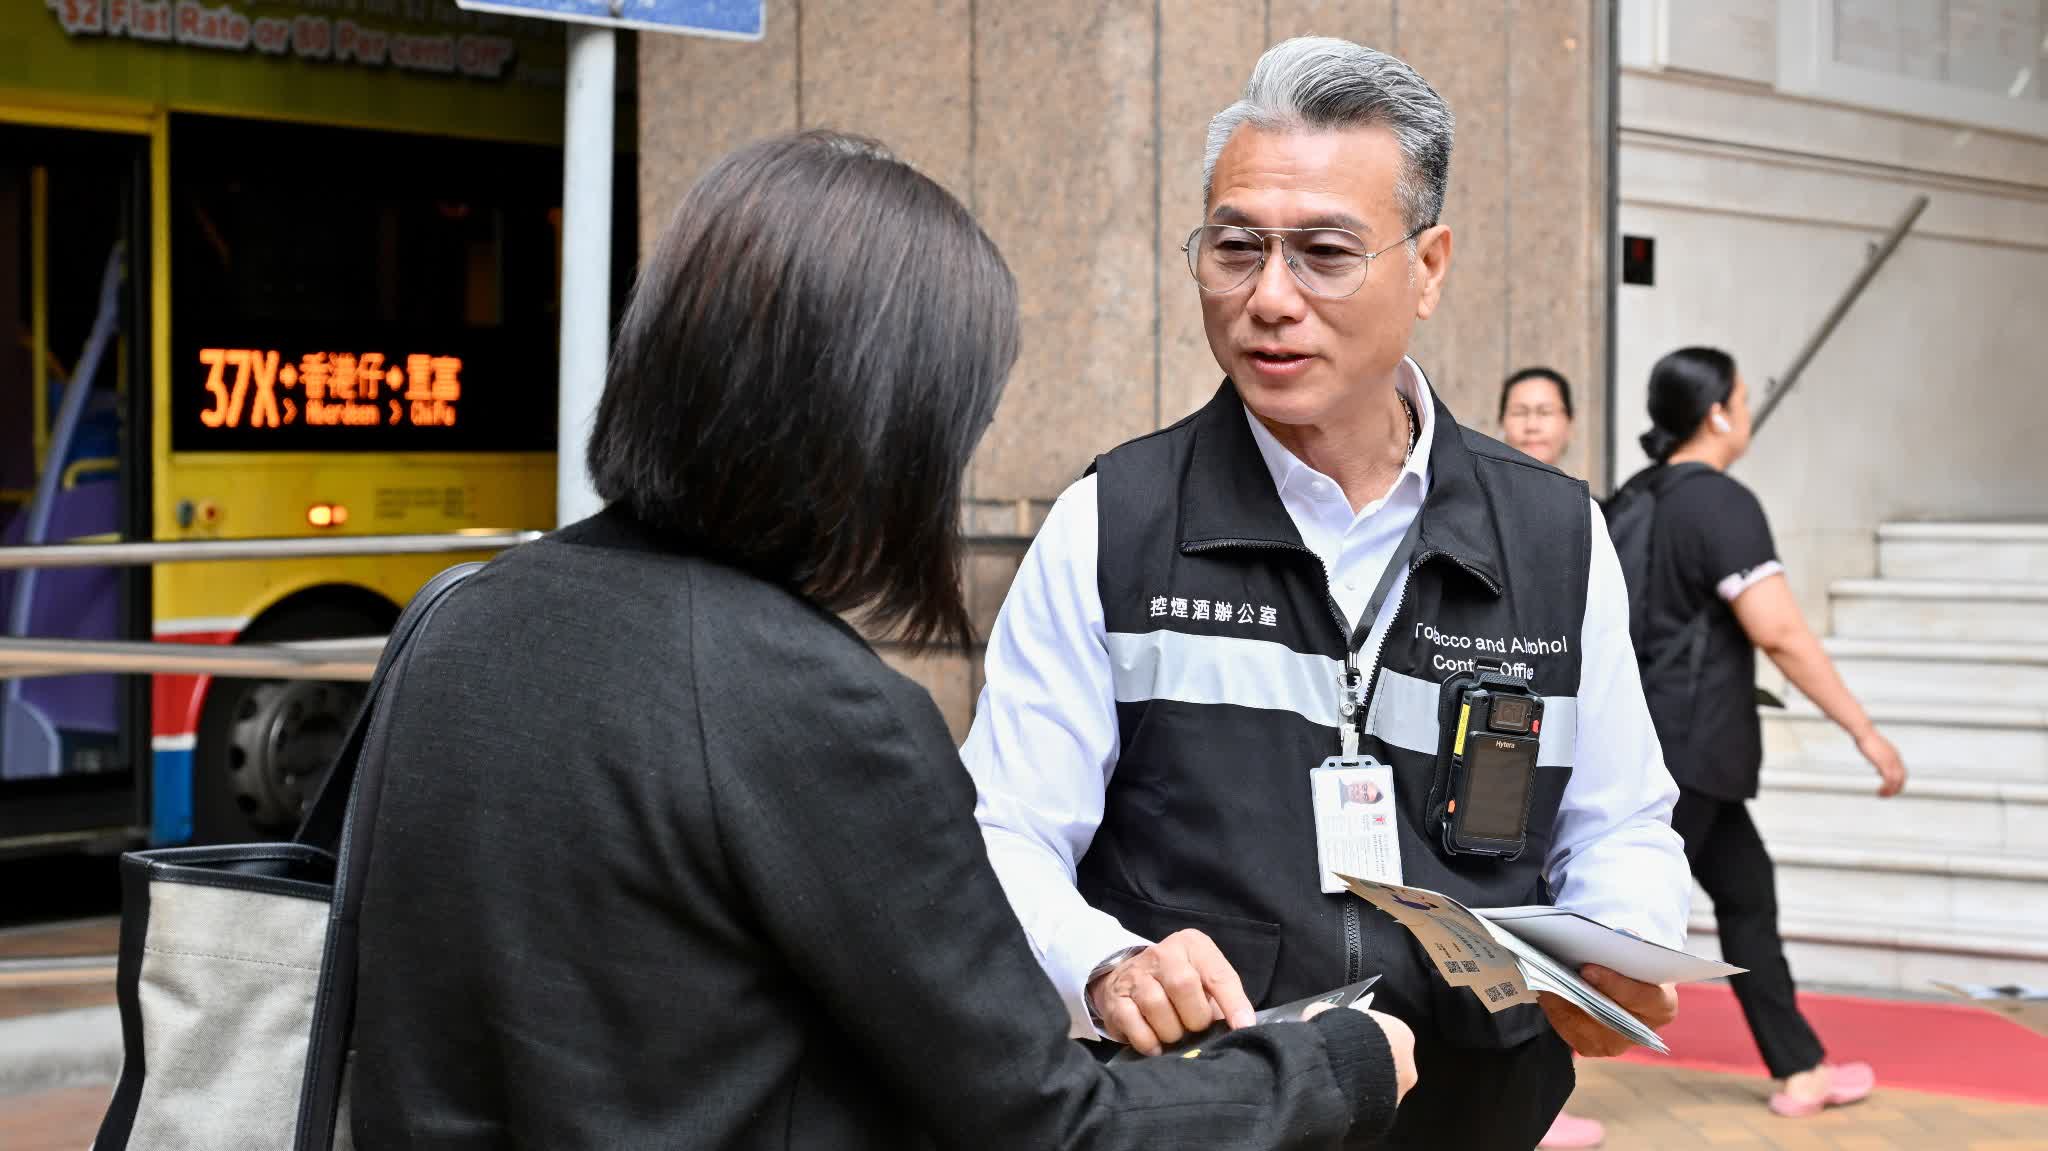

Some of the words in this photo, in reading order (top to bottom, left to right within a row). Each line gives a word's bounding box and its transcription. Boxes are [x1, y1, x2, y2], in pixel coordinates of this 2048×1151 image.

[174, 0, 251, 48] Rate
[253, 17, 289, 53] or
[200, 349, 279, 428] 37X
[299, 352, 385, 399] 香港仔
[1150, 595, 1277, 626] 控煙酒辦公室
[1475, 636, 1507, 653] and
[1495, 739, 1516, 749] Hytera
